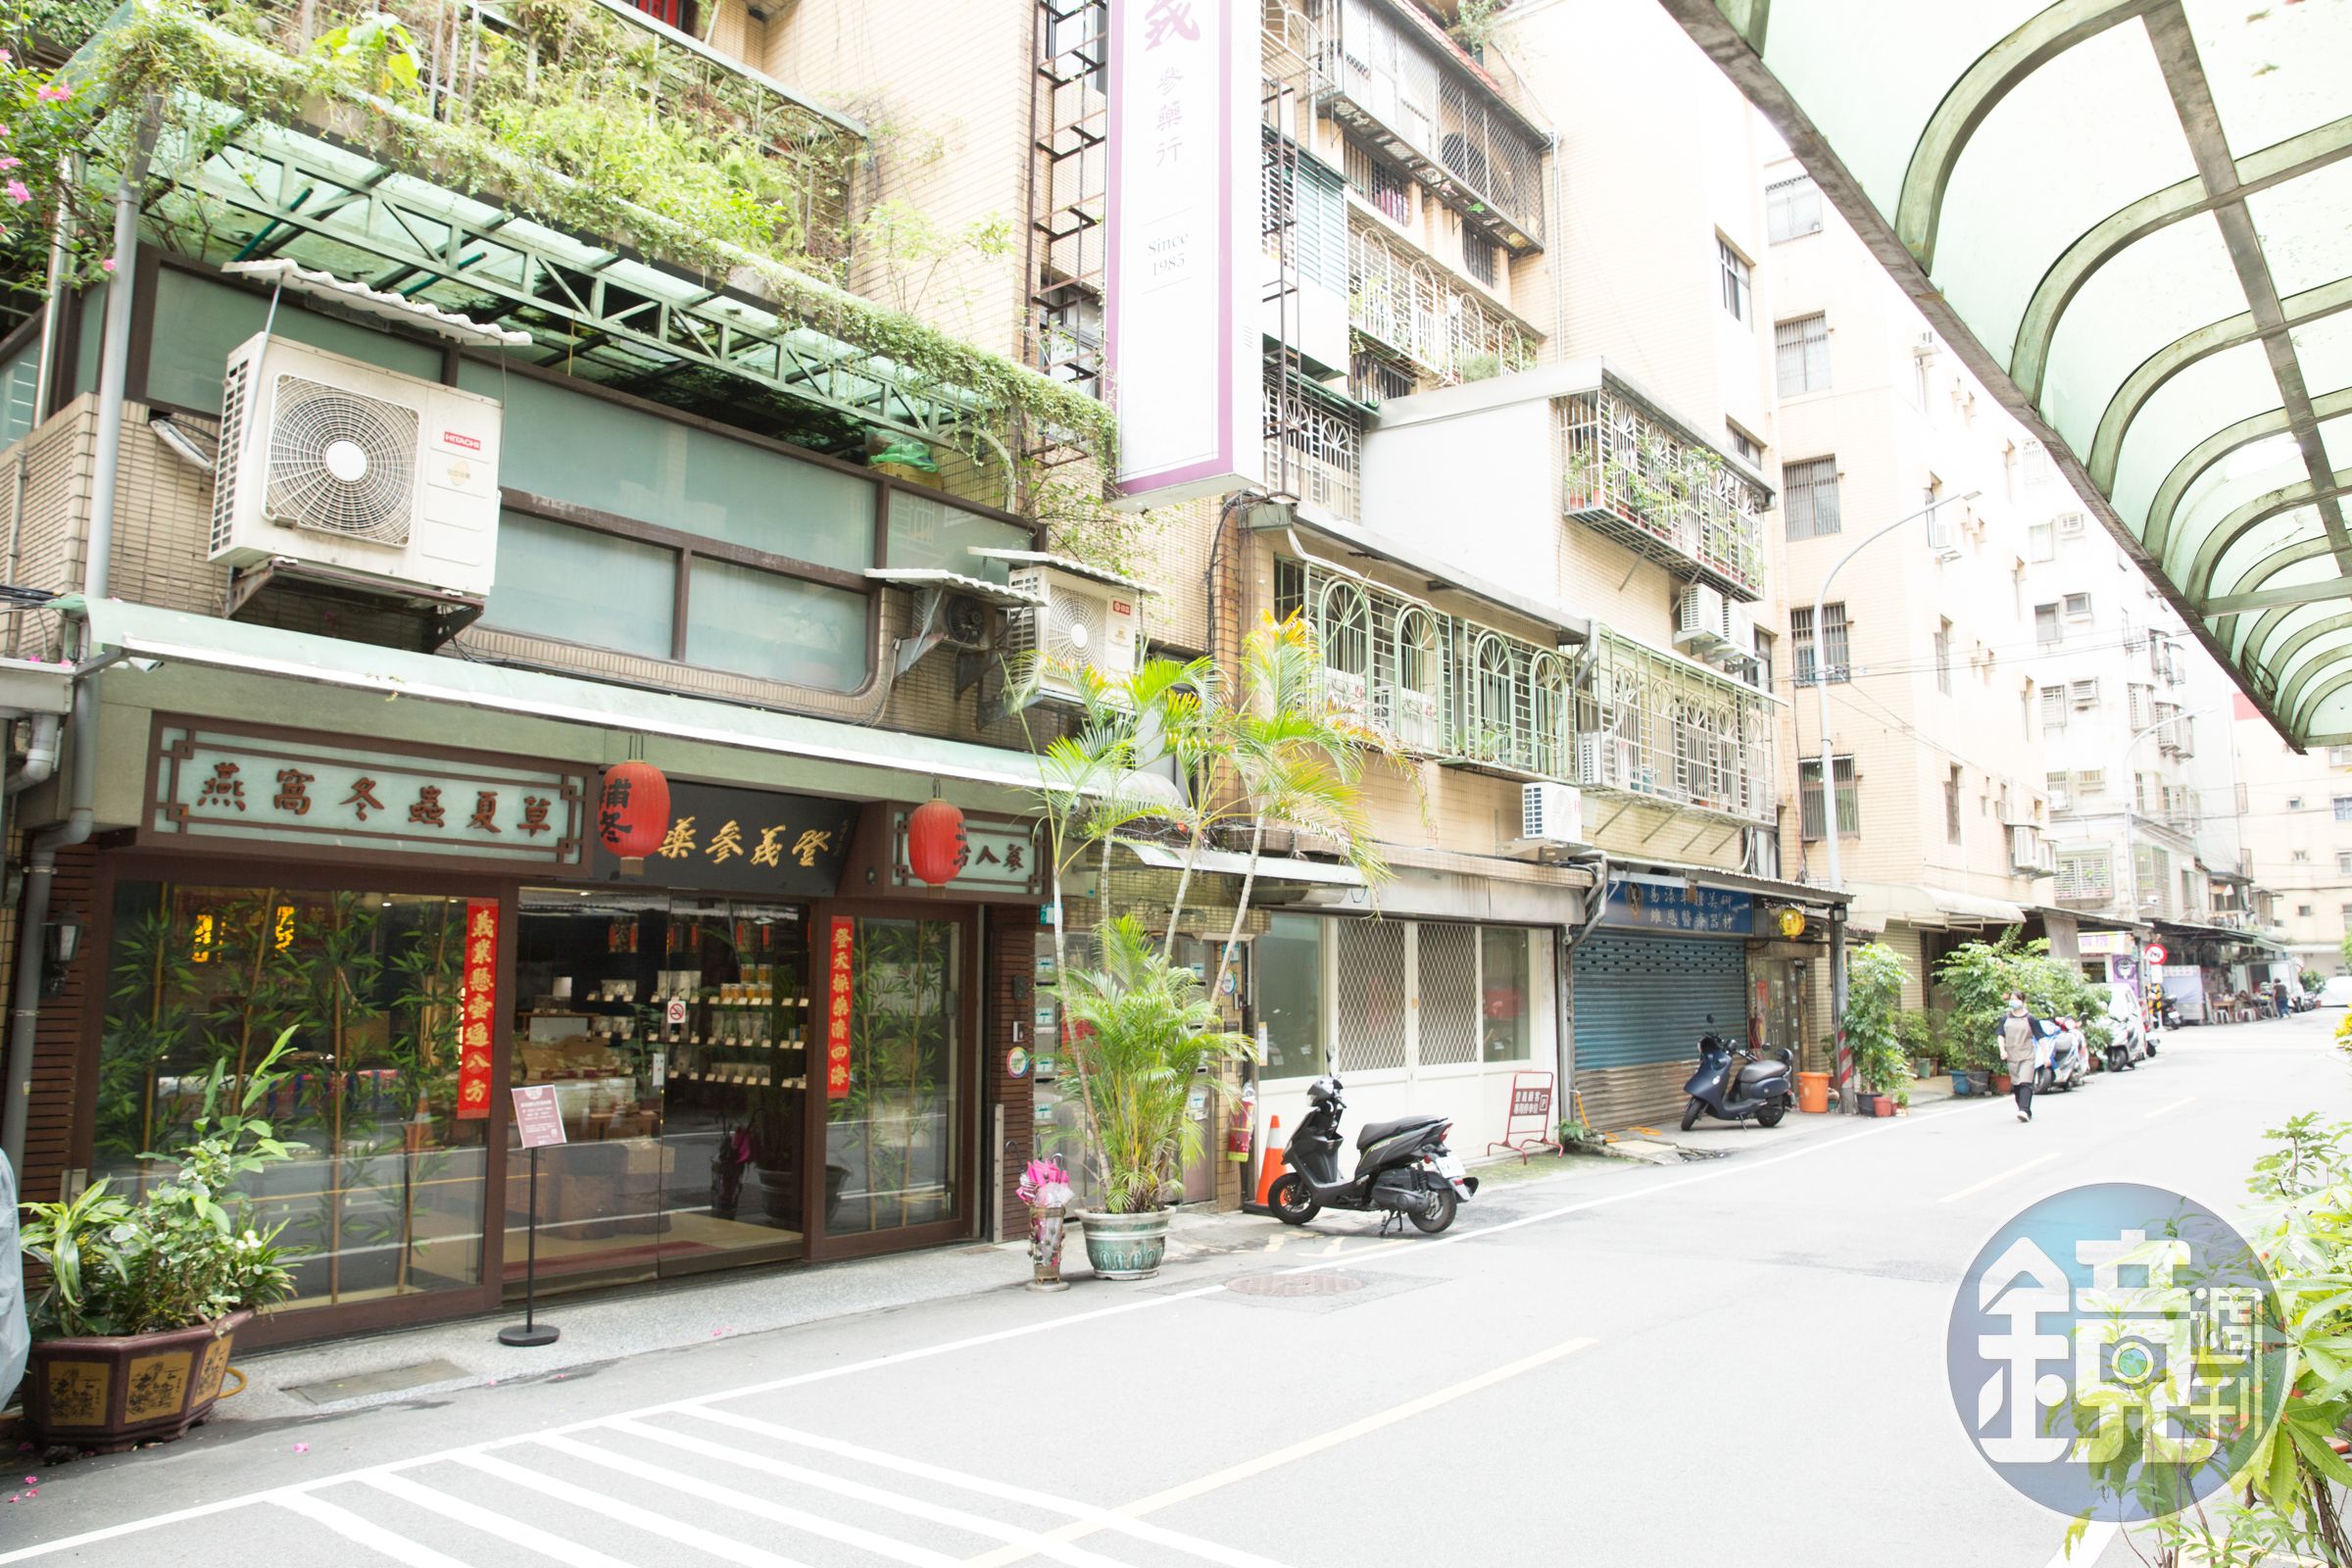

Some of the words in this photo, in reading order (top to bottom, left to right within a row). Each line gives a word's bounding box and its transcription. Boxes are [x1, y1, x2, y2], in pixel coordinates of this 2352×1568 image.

[1152, 252, 1186, 276] 1985
[445, 433, 480, 450] HITACHI
[197, 761, 552, 837] 燕窩冬蟲夏草
[964, 843, 1025, 873] 人蔘
